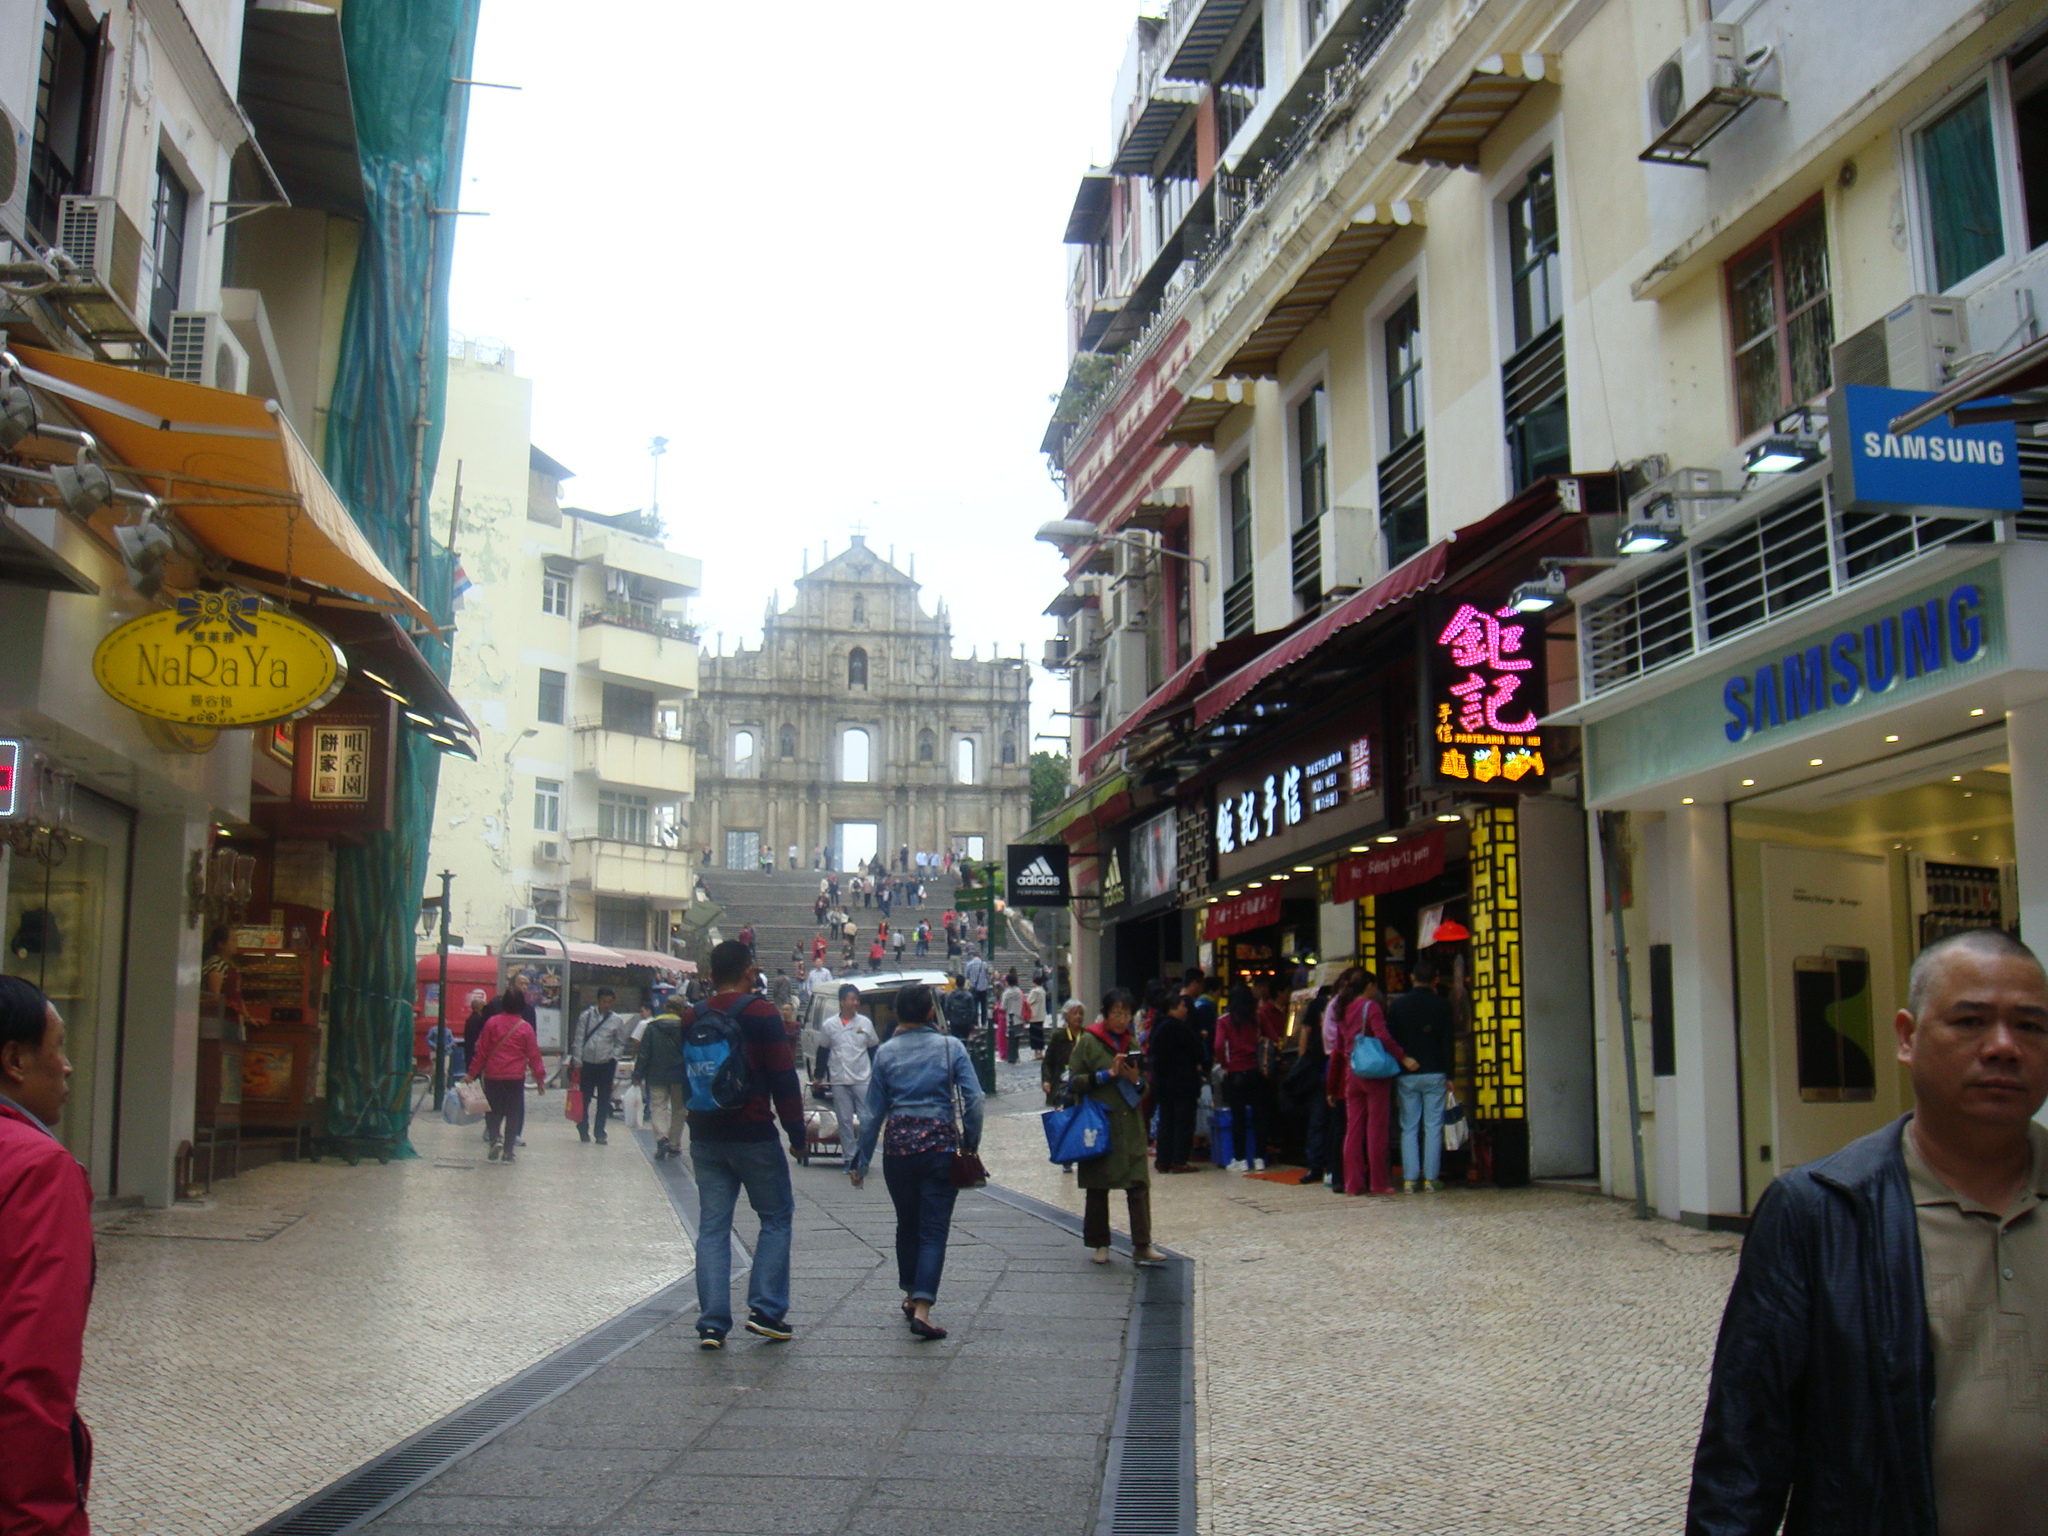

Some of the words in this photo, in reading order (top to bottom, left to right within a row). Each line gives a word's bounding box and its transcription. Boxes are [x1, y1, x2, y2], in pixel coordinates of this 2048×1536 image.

[1864, 431, 2005, 466] SAMSUNG
[136, 644, 289, 688] NaRaYa
[1723, 585, 1985, 742] SAMSUNG
[319, 734, 338, 773] 餅家
[1508, 735, 1524, 746] KOI
[1305, 750, 1343, 778] PASTELARIA
[1016, 874, 1060, 887] adidas
